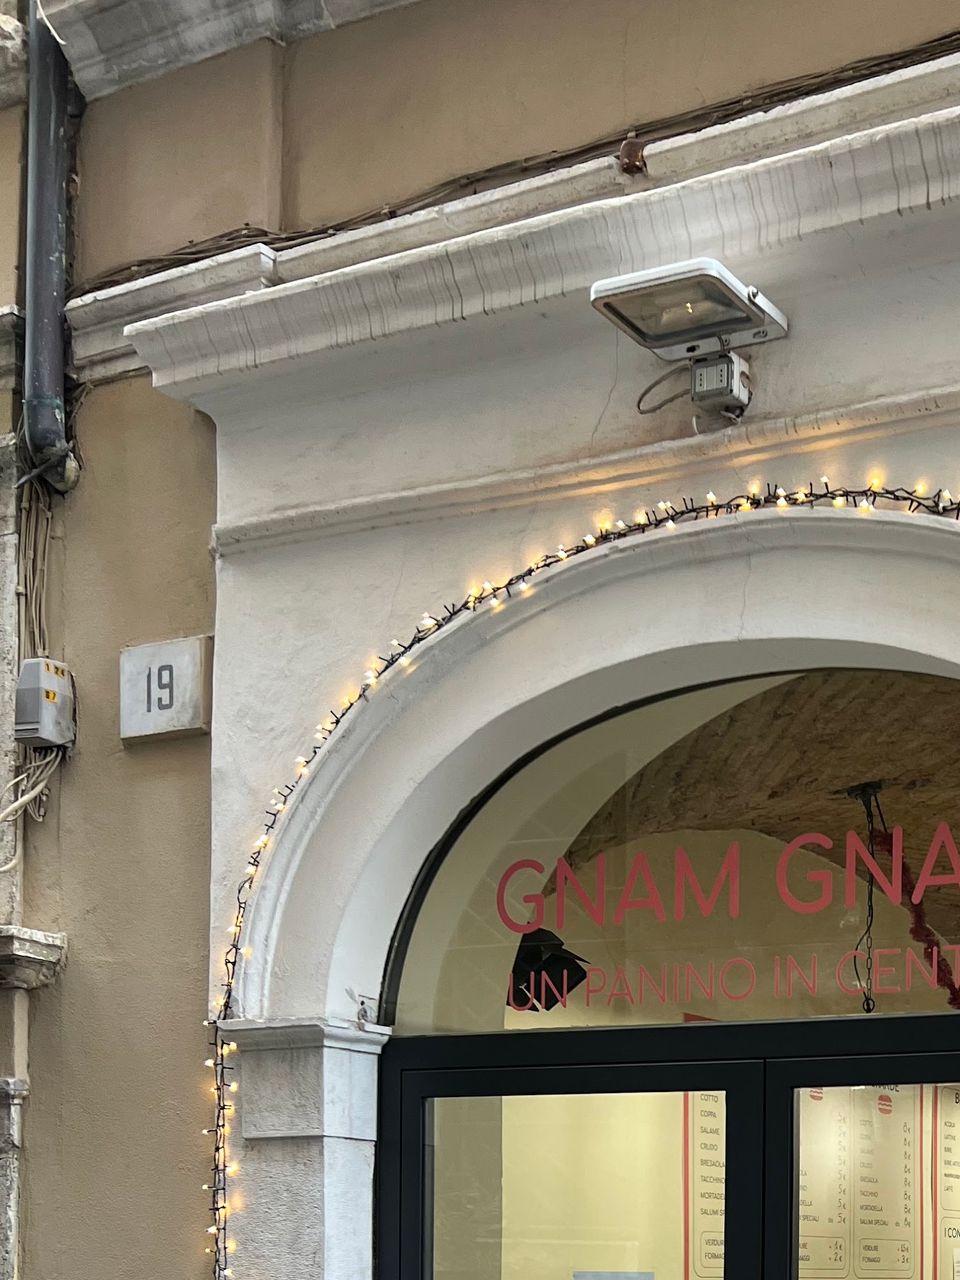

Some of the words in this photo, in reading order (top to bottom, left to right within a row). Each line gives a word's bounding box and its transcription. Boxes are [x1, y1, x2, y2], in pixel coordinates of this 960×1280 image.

[147, 664, 174, 713] 19
[496, 841, 740, 934] GNAM
[507, 969, 568, 1012] UN
[585, 957, 756, 1008] PANINO
[773, 953, 817, 999] IN
